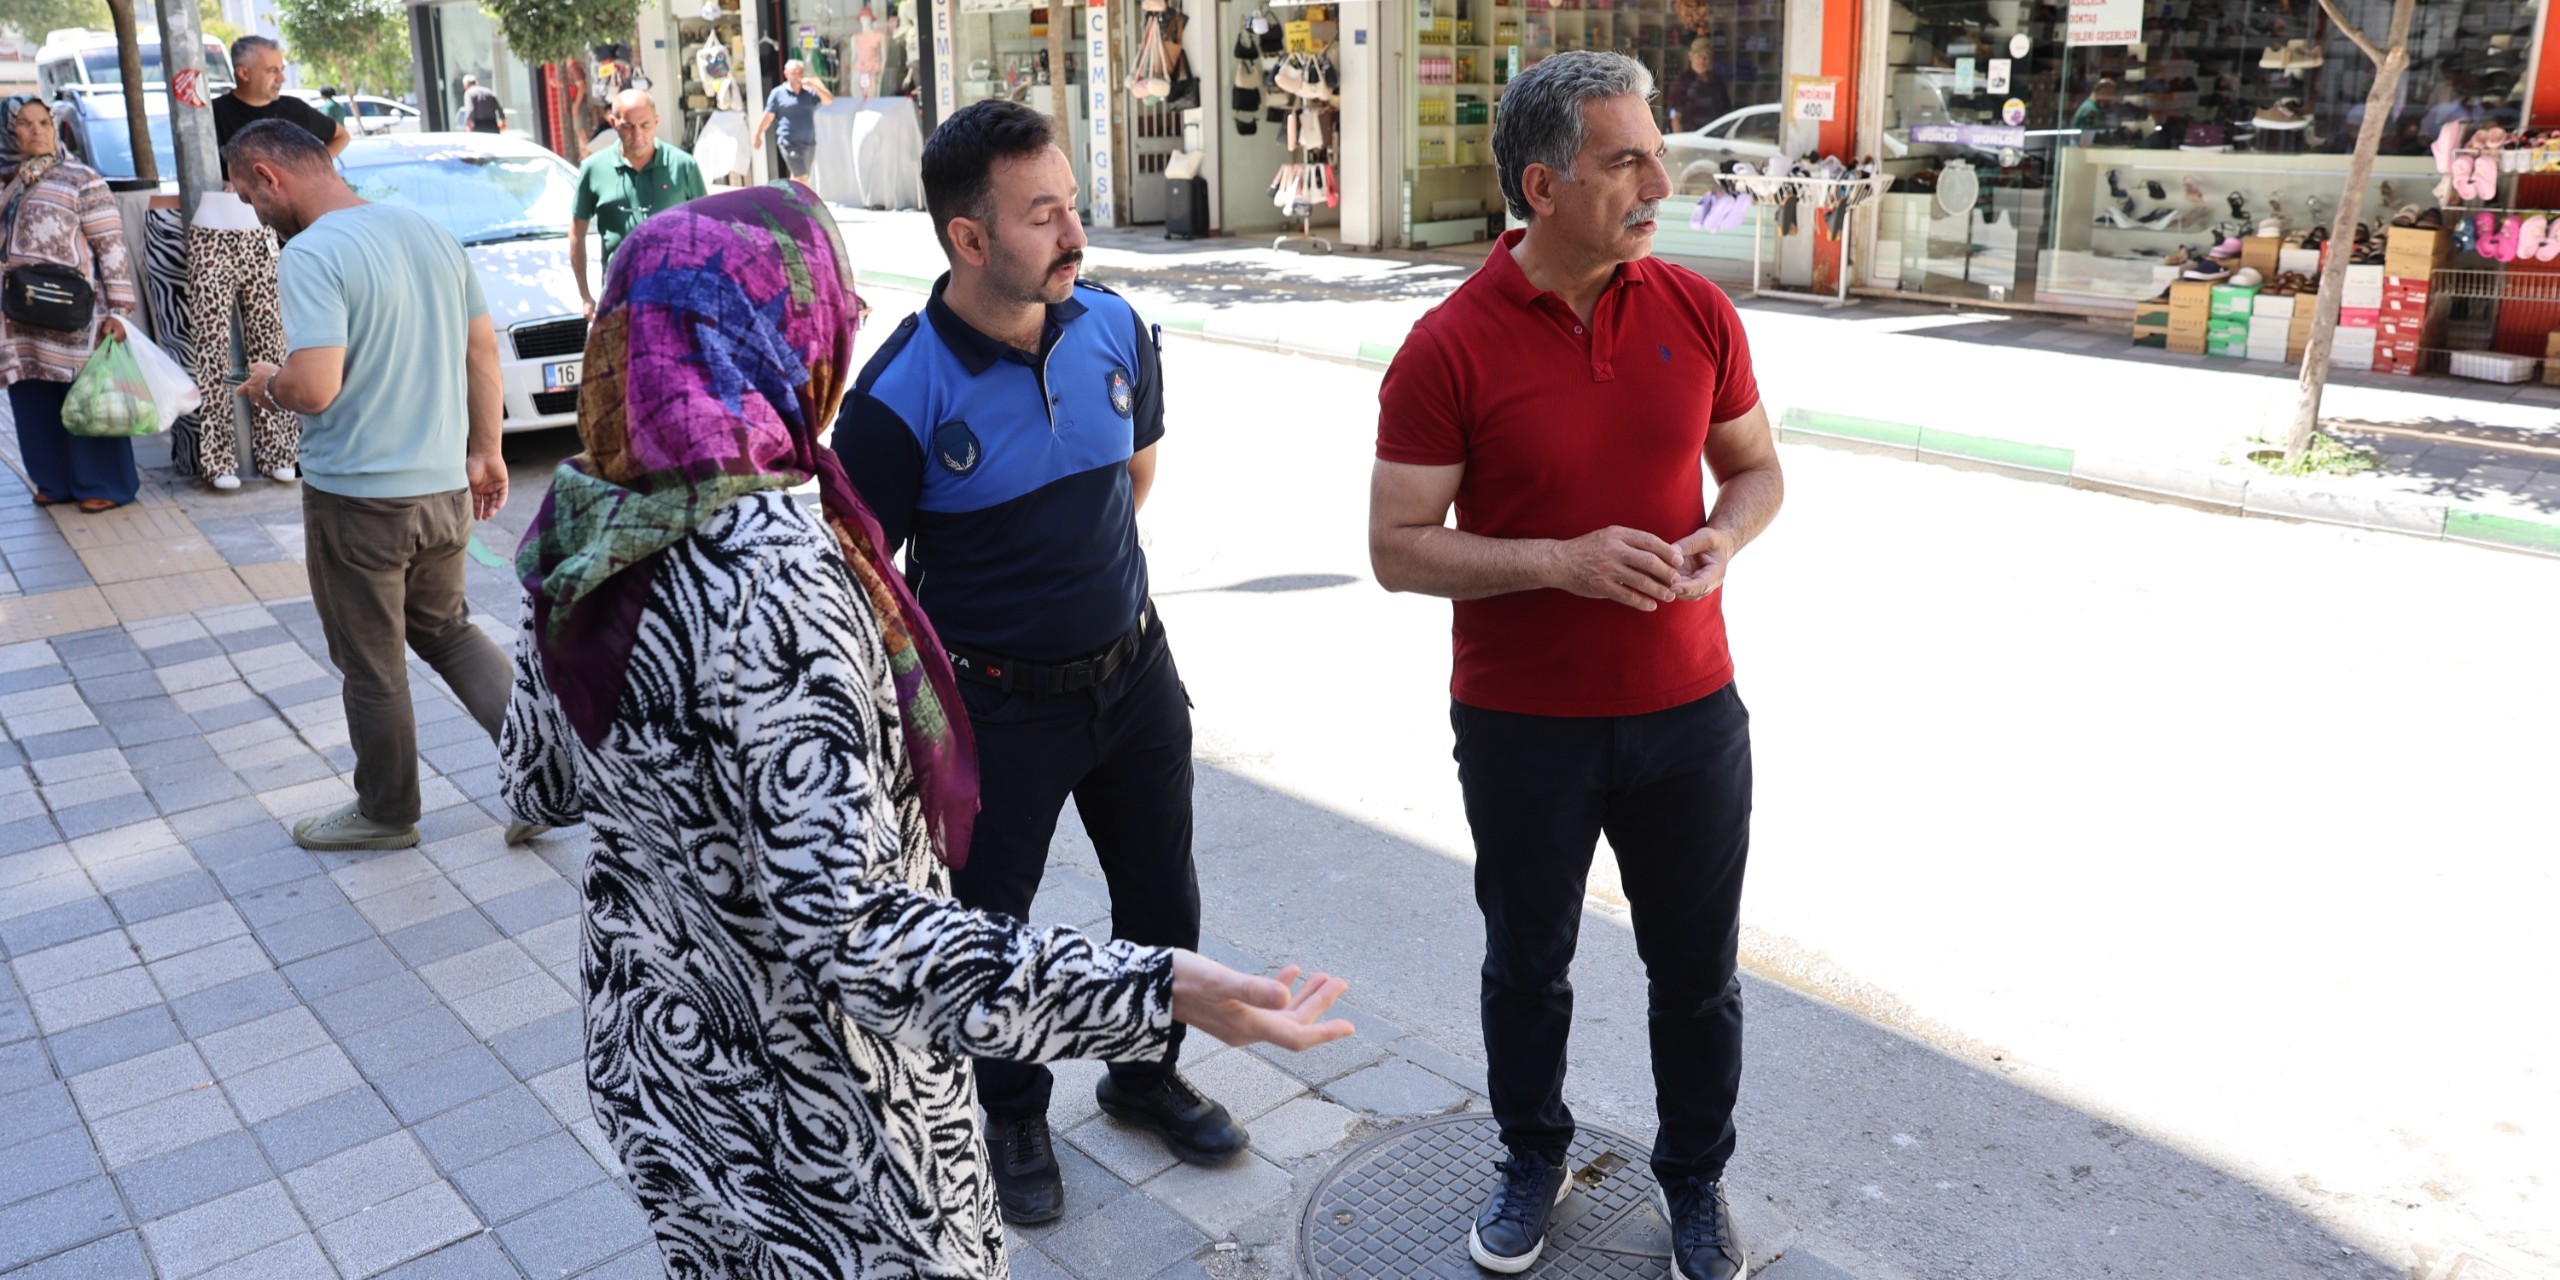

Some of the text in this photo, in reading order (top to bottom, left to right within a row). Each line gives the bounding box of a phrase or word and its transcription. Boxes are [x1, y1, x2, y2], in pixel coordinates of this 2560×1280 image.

[1091, 15, 1110, 219] CEMRE GSM
[558, 365, 575, 384] 16
